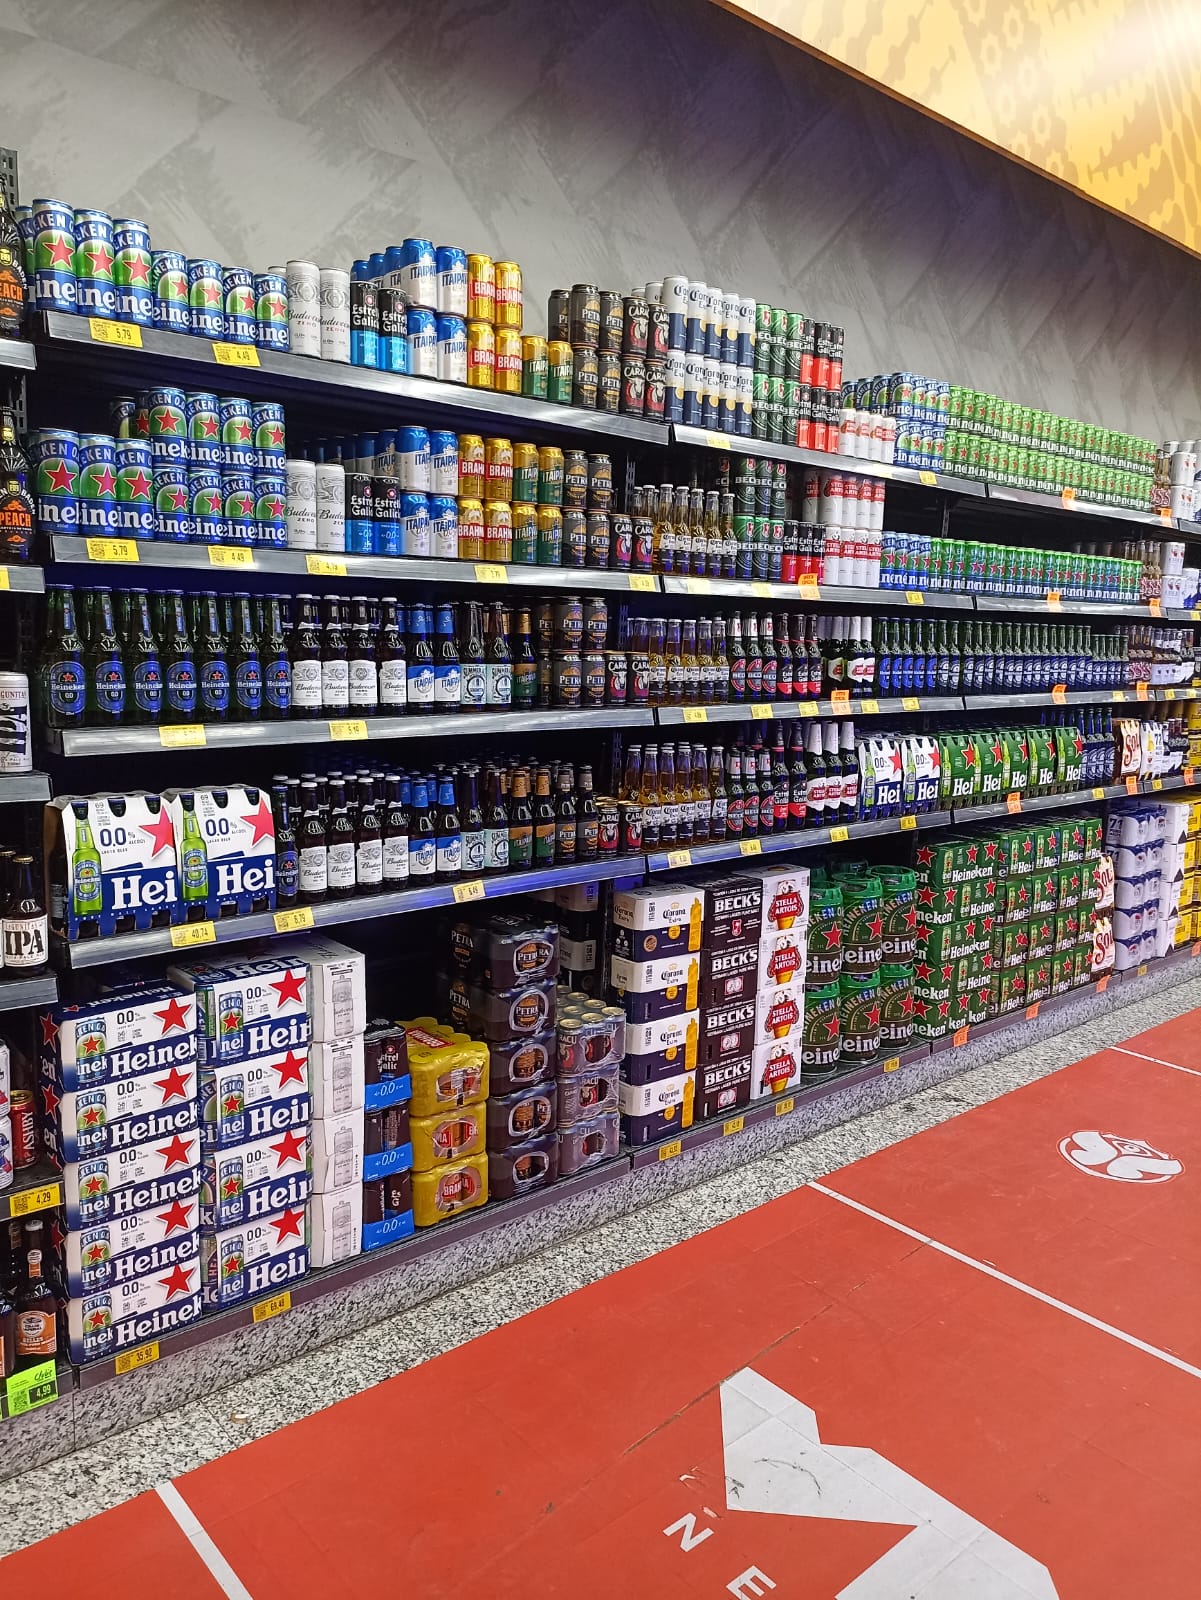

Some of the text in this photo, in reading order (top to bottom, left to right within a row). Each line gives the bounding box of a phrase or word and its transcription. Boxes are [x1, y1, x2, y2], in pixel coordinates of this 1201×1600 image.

[0, 512, 31, 527] PEACH
[877, 784, 900, 805] Hei
[917, 780, 939, 801] Hei
[100, 827, 127, 847] 0.0
[206, 818, 229, 837] 0.0
[216, 859, 275, 896] Hei
[951, 865, 993, 882] Heineken
[111, 871, 178, 910] Hei
[715, 891, 761, 913] BECK'S
[775, 897, 798, 915] STELLA ARTOIS
[5, 929, 44, 956] IPA
[949, 938, 990, 957] Heineken
[712, 949, 758, 972] BECK'S
[774, 952, 796, 970] STELLA ARTOIS
[707, 1004, 754, 1029] BECK'S
[772, 1006, 794, 1024] STELLA ARTOIS
[705, 1060, 751, 1086] BECK'S
[769, 1061, 791, 1071] STELLA
[769, 1068, 791, 1079] ARTOIS
[36, 1191, 51, 1205] 4,29
[36, 1384, 51, 1398] 4,99
